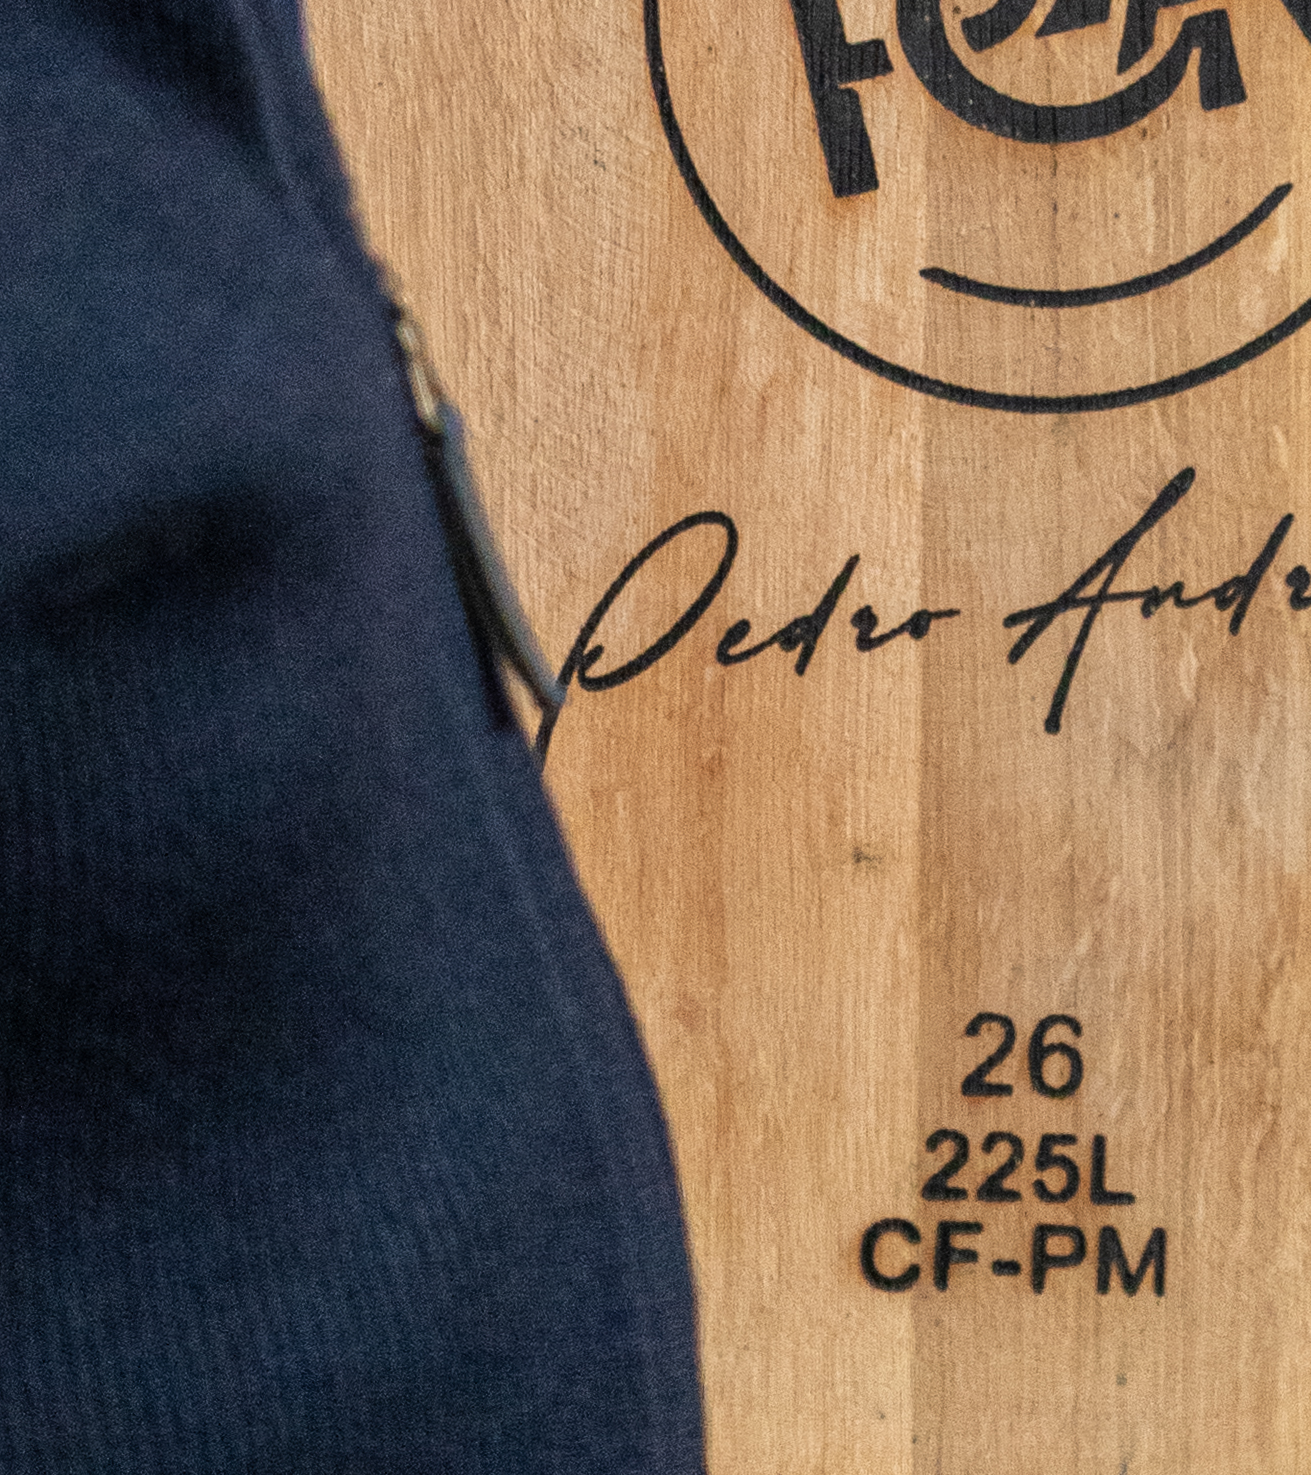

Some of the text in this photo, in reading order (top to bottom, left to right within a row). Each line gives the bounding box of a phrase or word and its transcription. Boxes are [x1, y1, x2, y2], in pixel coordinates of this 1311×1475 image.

[536, 510, 960, 774] Pedro
[960, 1011, 1085, 1100] 26
[921, 1128, 1136, 1206] 225L
[859, 1218, 1167, 1298] CF-PM
